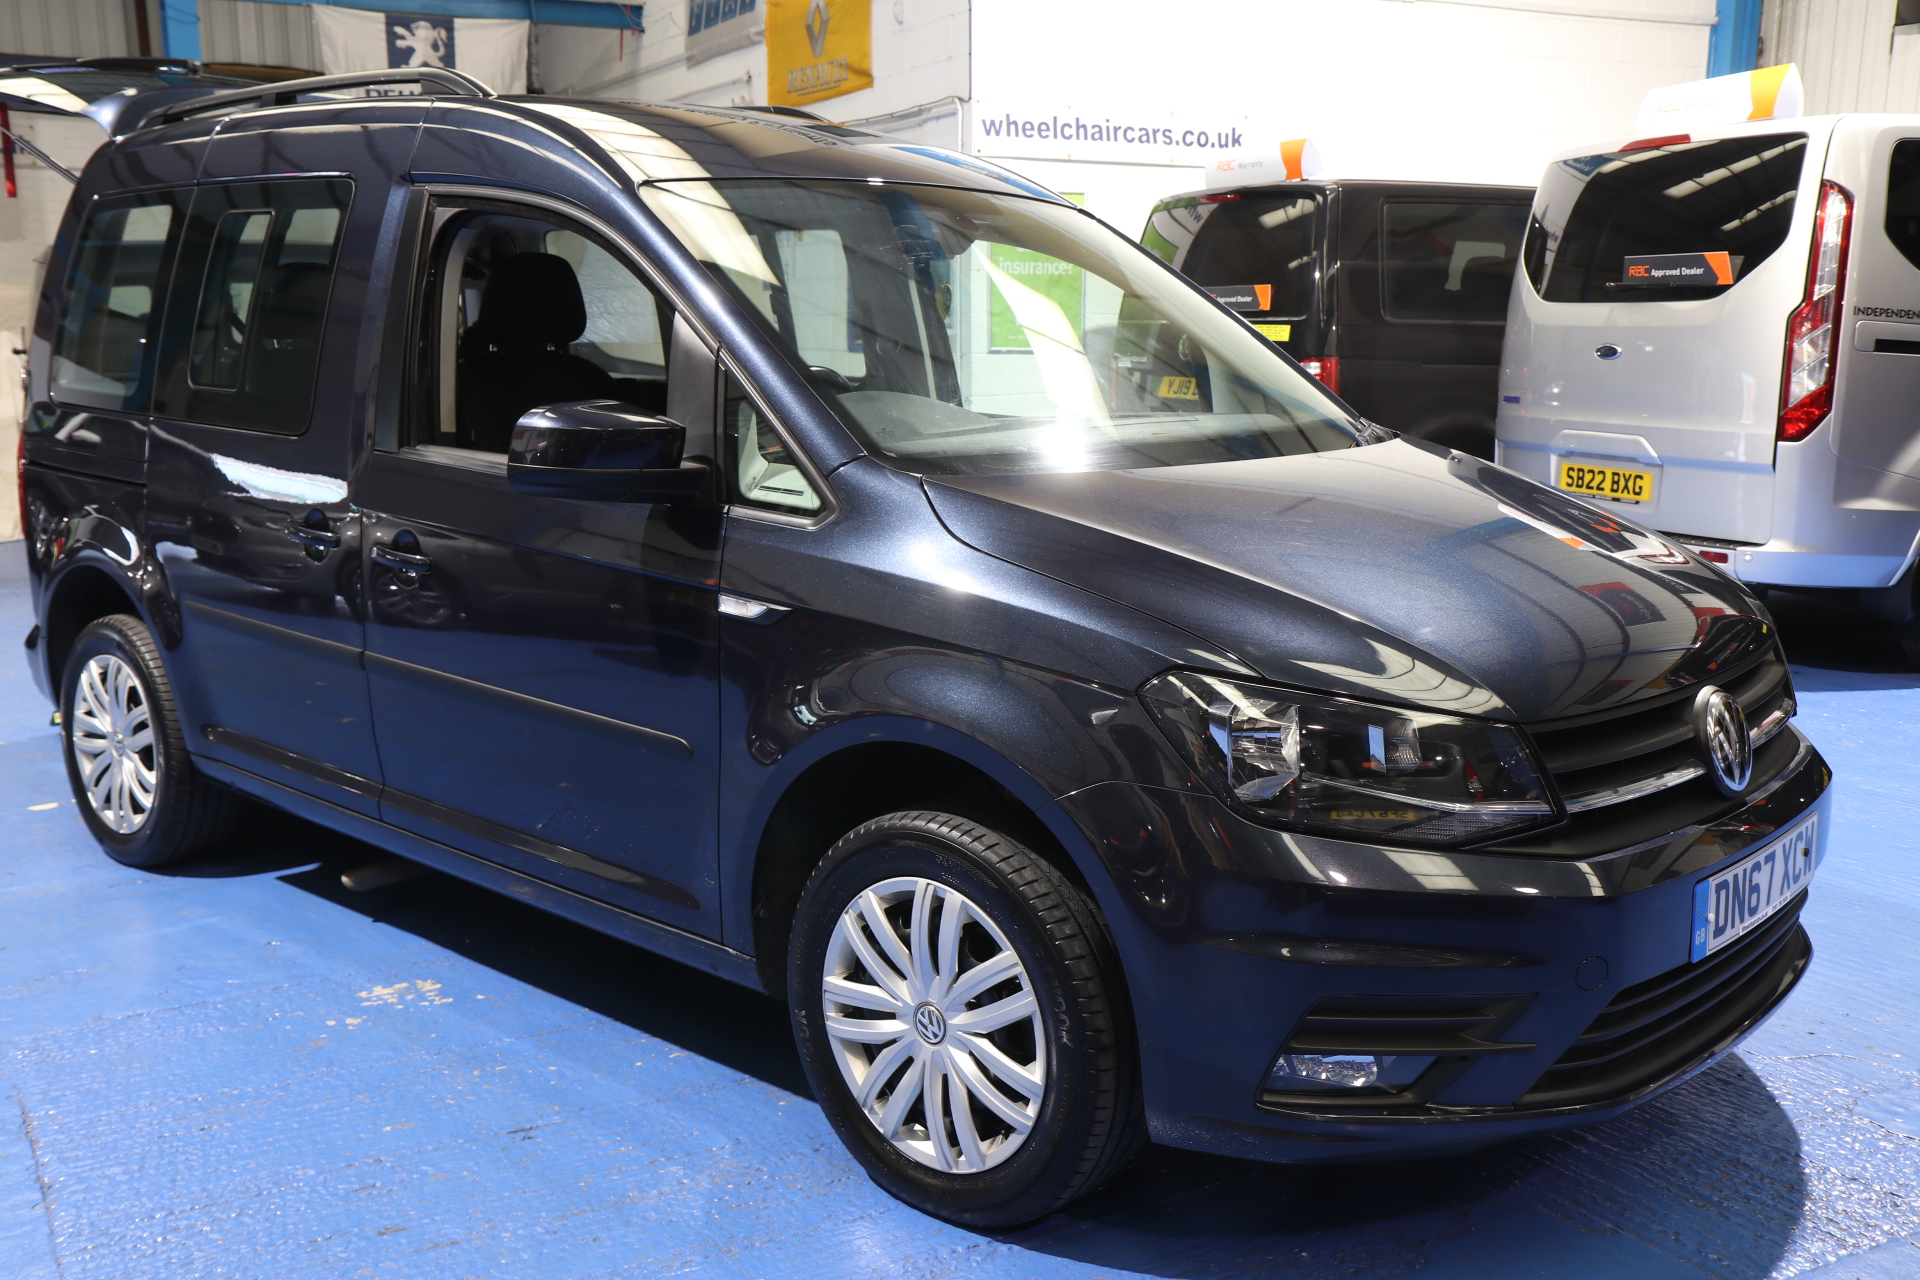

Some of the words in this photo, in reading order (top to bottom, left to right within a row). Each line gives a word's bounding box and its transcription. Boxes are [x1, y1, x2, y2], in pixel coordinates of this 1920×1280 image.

[787, 57, 849, 94] RENAULT
[981, 113, 1243, 149] wheelchaircars.co.uk
[998, 256, 1074, 275] insurance?
[1628, 265, 1650, 277] RAC
[1650, 268, 1680, 278] Approved
[1681, 266, 1705, 276] Dealer
[1167, 379, 1192, 396] YJ19
[1565, 466, 1606, 491] SB22
[1610, 471, 1644, 496] BXG
[1712, 850, 1777, 941] DN67
[1779, 820, 1815, 896] XCW
[1695, 928, 1706, 946] GB
